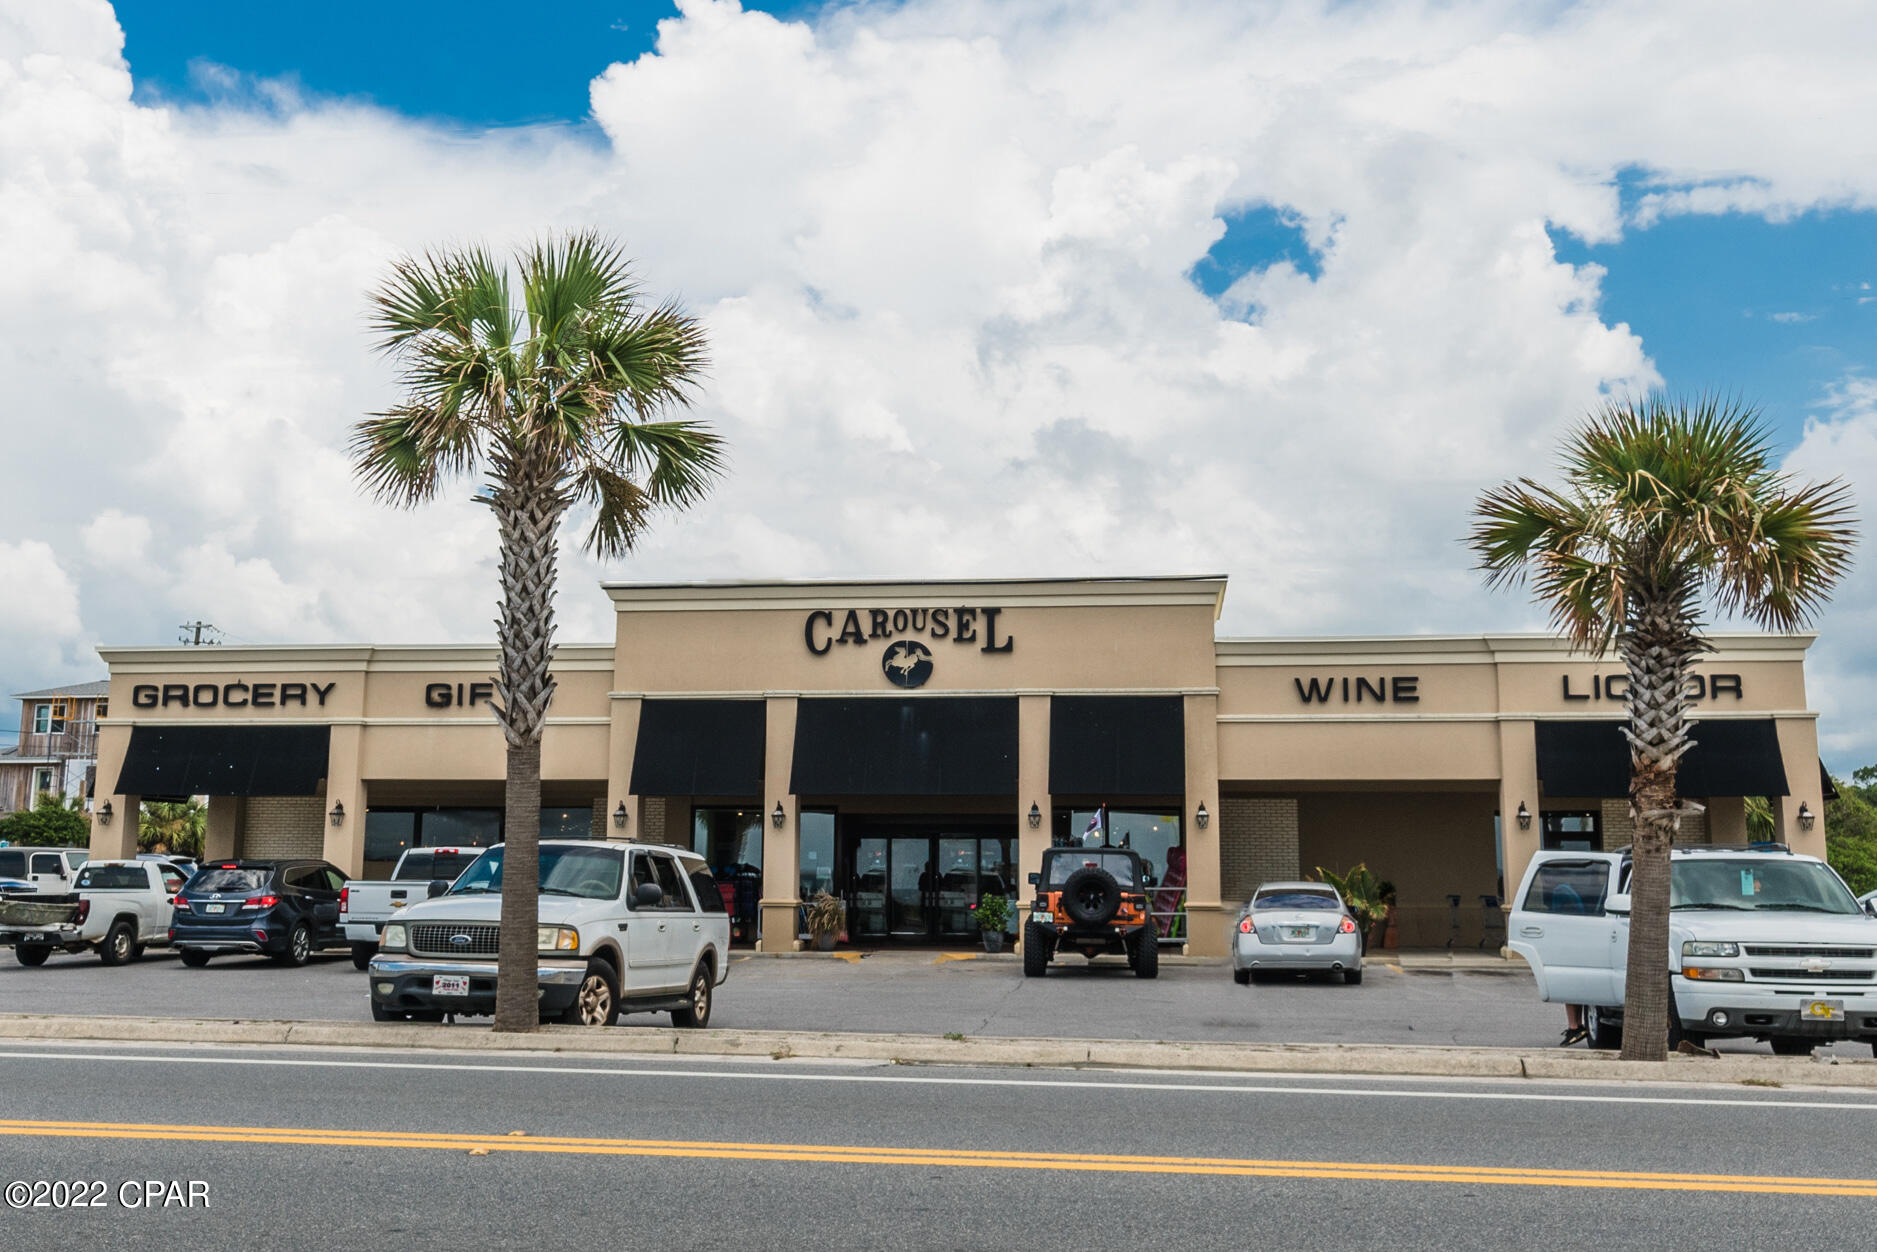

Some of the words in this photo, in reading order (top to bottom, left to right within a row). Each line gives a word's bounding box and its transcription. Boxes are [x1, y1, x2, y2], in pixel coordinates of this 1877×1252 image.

[804, 607, 1014, 656] CAROUSEL
[132, 682, 337, 708] GROCERY
[425, 682, 551, 707] GIF
[1294, 676, 1420, 704] WINE
[1562, 674, 1743, 700] LIQOR
